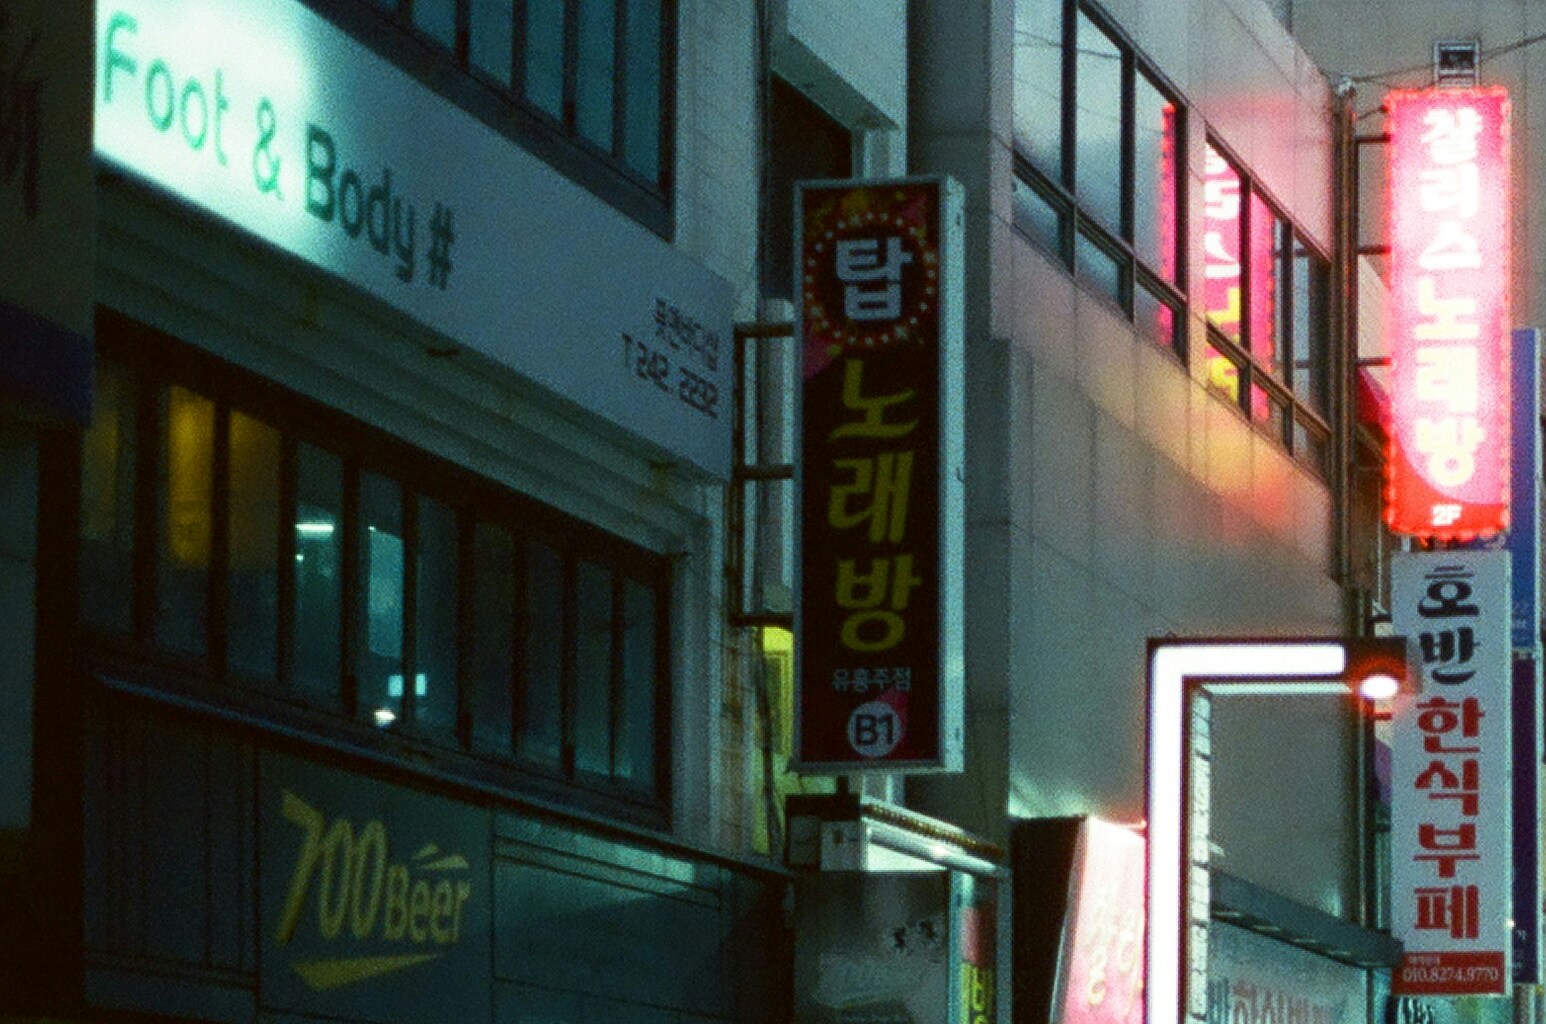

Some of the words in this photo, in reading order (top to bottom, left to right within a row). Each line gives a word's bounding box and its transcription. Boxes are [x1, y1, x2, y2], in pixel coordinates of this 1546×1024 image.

[102, 11, 230, 166] Foot
[252, 99, 285, 200] &
[304, 122, 415, 285] Body
[836, 236, 914, 321] 탑
[827, 358, 923, 652] 노래방
[1430, 504, 1463, 526] 2F
[1417, 565, 1480, 685] 호반
[853, 714, 896, 747] B1
[274, 788, 388, 948] 700
[383, 864, 471, 944] Beer
[1413, 696, 1486, 940] 한식부페
